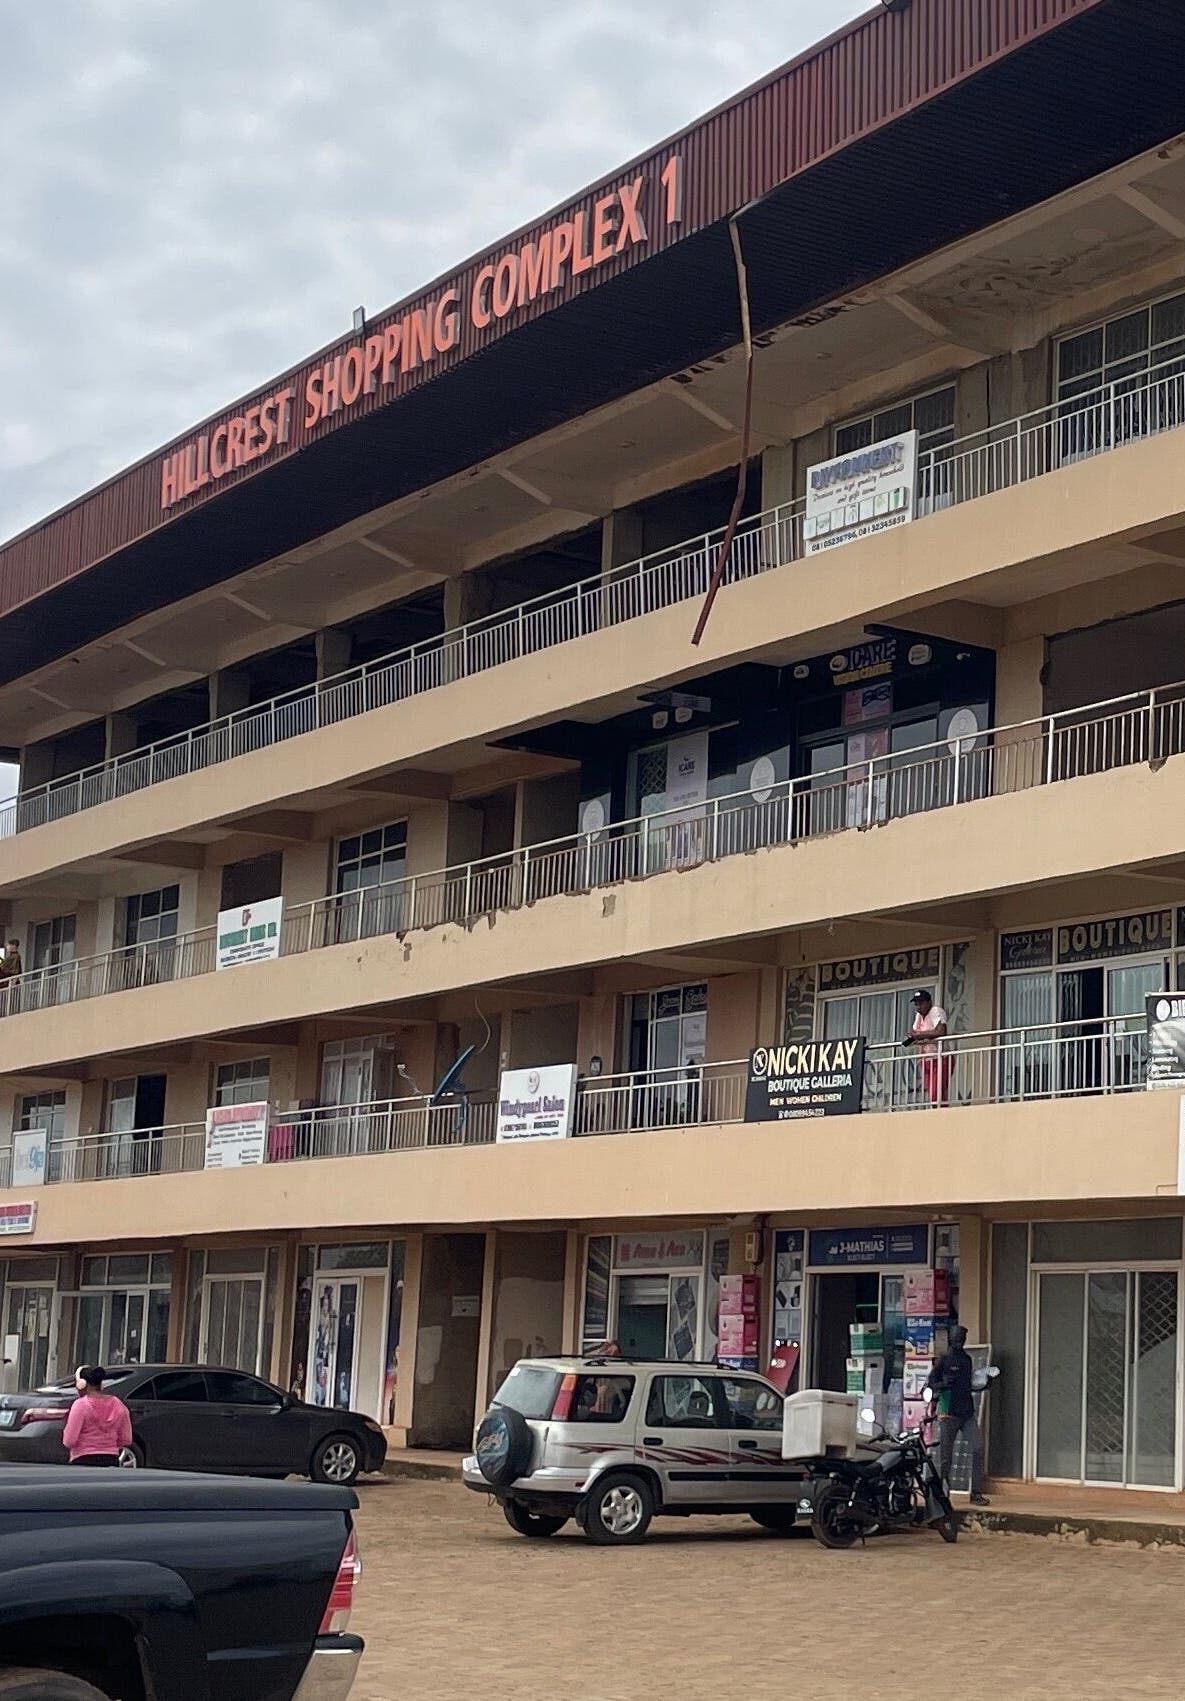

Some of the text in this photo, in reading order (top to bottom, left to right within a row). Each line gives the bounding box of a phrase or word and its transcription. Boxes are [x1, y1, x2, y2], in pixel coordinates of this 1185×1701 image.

[161, 155, 684, 510] HILLCREST SHOPPING COMPLEX 1
[1059, 911, 1172, 955] BOUTIQUE
[821, 950, 938, 983] BOUTIQUE
[768, 1073, 852, 1093] BOUTIQUE GALLERIA
[770, 1093, 842, 1106] MEN WOMEN CHILDREN
